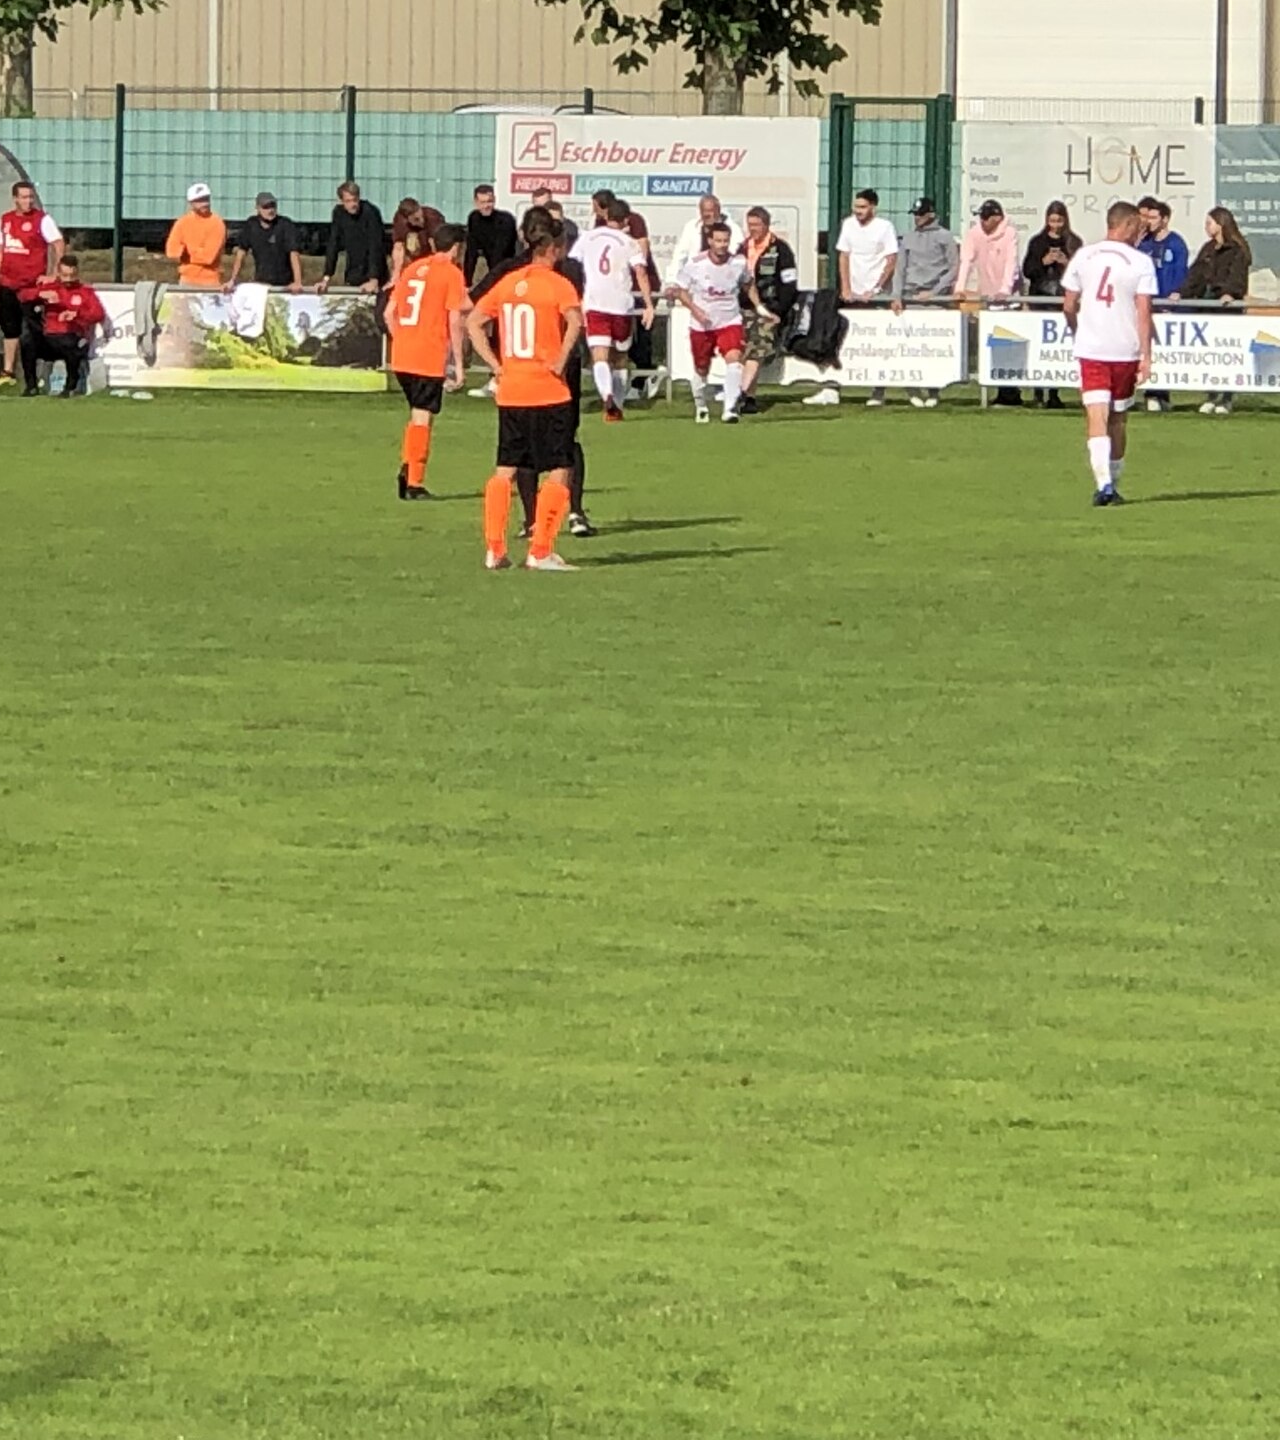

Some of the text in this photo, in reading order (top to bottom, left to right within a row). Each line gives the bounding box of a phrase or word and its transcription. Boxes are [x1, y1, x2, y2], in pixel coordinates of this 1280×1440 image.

[561, 141, 664, 163] Eschbour
[669, 143, 747, 169] Energy
[1064, 136, 1195, 194] HOME
[598, 244, 611, 275] 6
[400, 279, 425, 326] 3
[1096, 266, 1115, 308] 4
[503, 303, 536, 359] 10
[990, 367, 1079, 382] ERPELDANG
